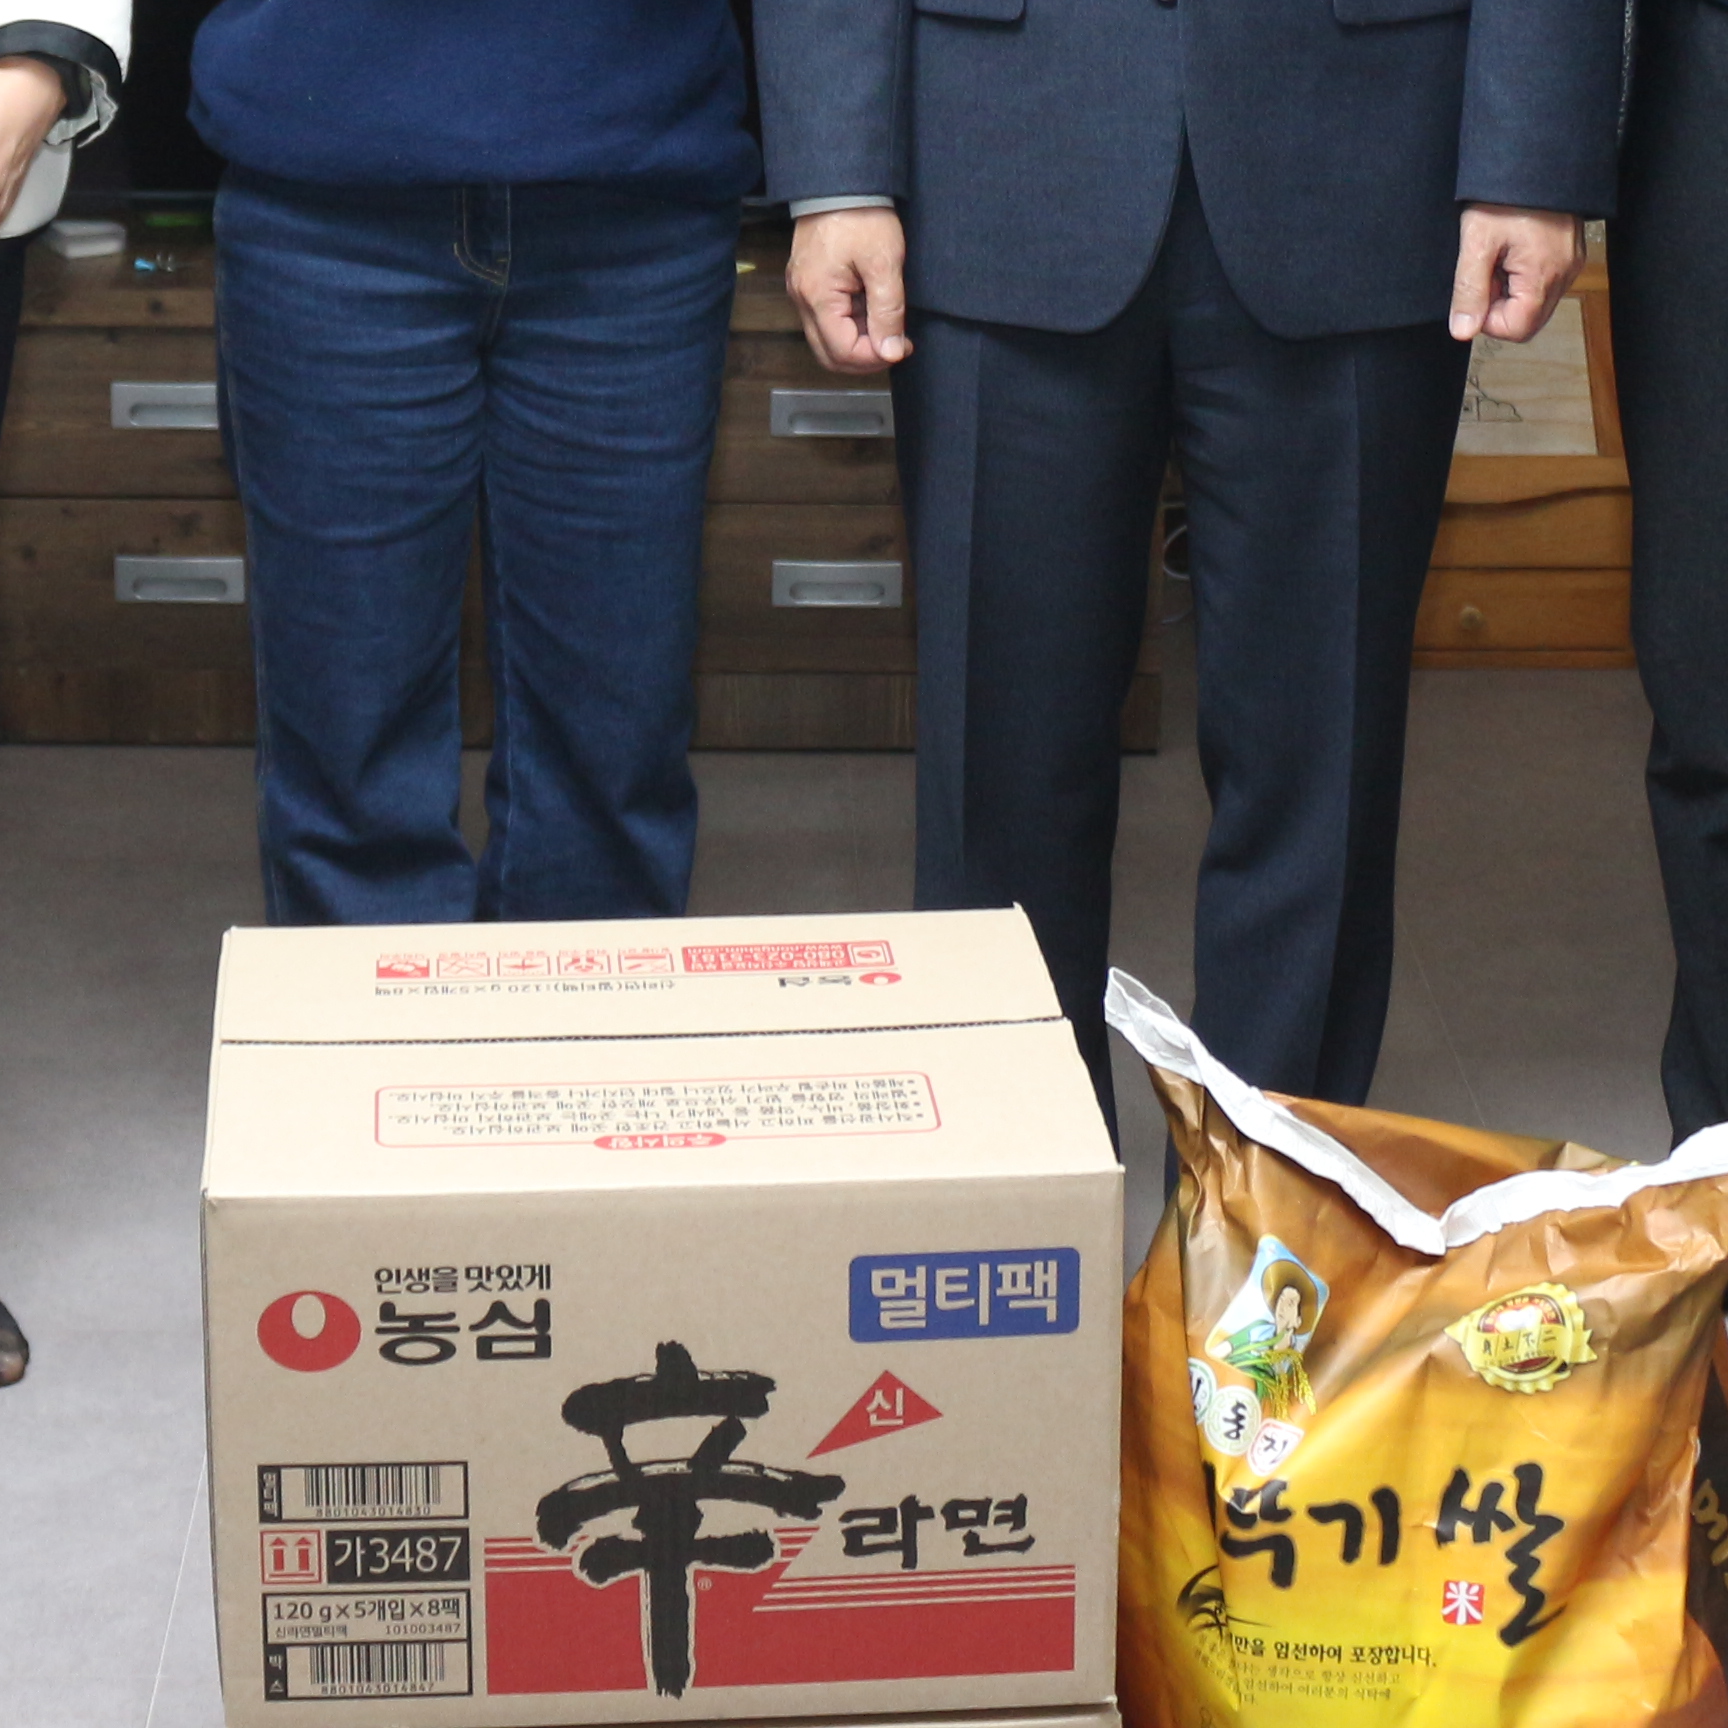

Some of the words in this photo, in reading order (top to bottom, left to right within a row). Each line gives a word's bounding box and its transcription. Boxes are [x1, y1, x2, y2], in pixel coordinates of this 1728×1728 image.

[610, 1134, 713, 1149] 주의사항
[374, 1266, 459, 1294] 인생을
[464, 1264, 552, 1293] 맛있게
[869, 1260, 1060, 1329] 멀티팩
[374, 1298, 553, 1367] 농심
[867, 1388, 906, 1428] 신
[534, 1340, 846, 1699] 辛
[839, 1494, 1036, 1570] 라면
[334, 1536, 462, 1578] 가3487
[1434, 1461, 1566, 1649] 쌀
[273, 1601, 313, 1620] 120
[1442, 1580, 1484, 1625] 米
[385, 1623, 461, 1636] 101003487
[1229, 1632, 1265, 1657] 만을
[1274, 1641, 1343, 1665] 엄선하여
[1349, 1644, 1436, 1668] 포장합니다.
